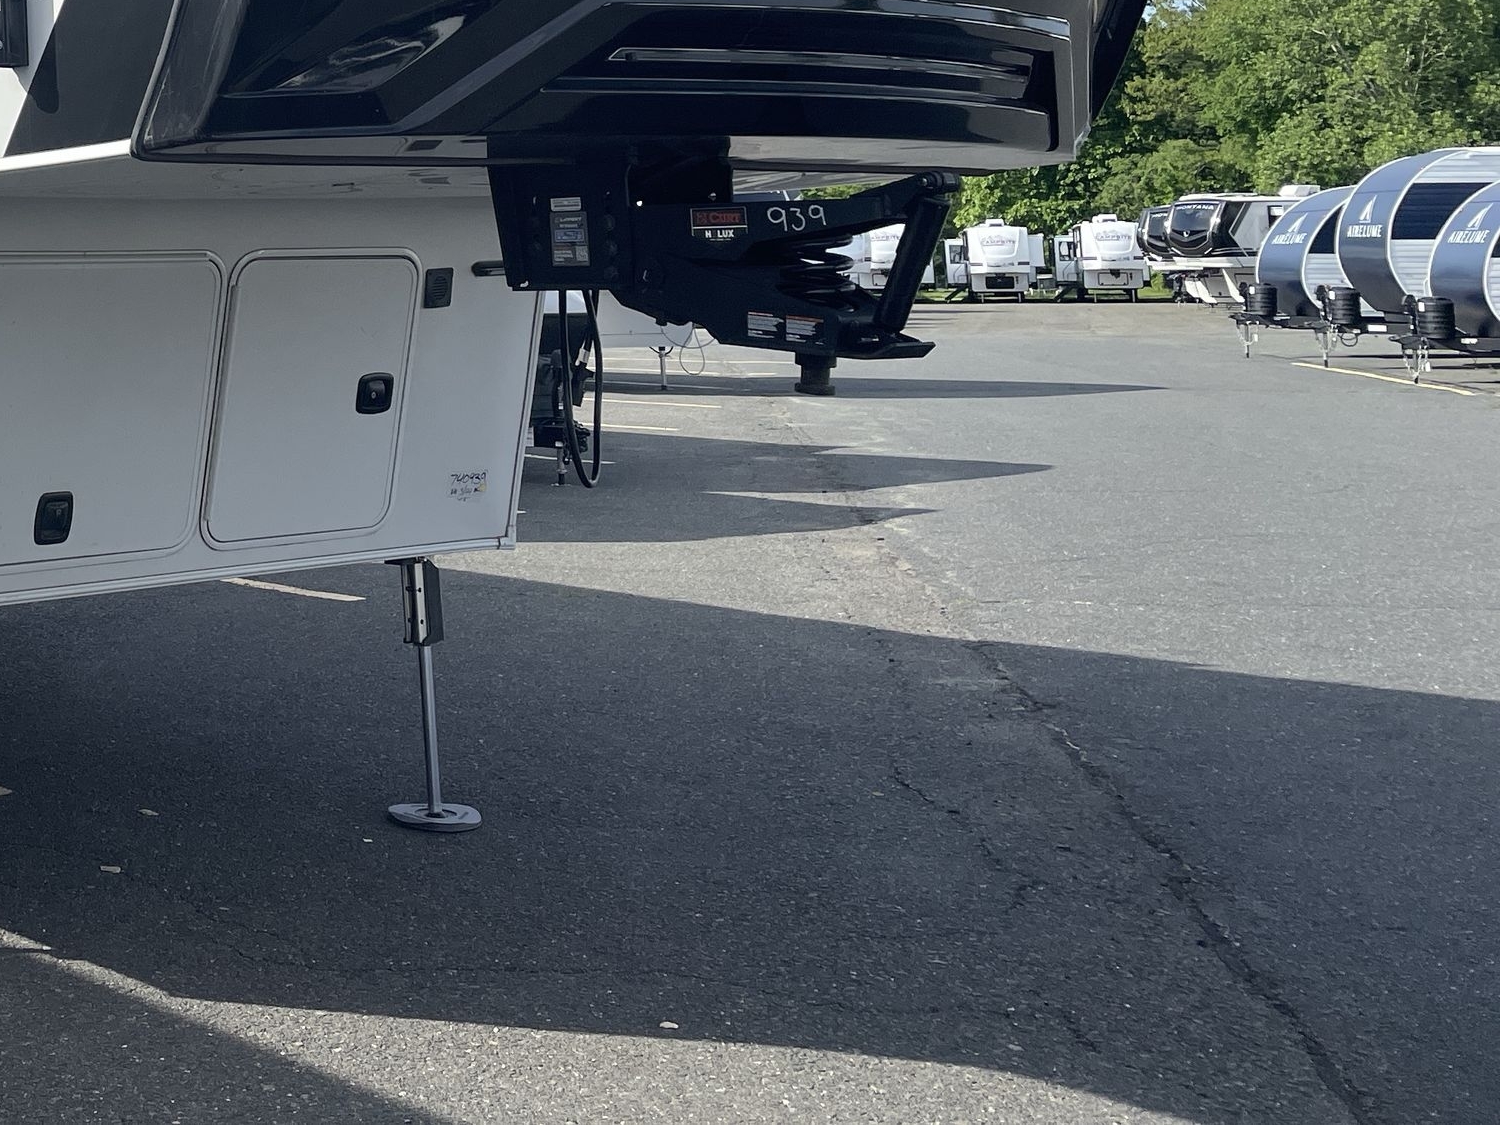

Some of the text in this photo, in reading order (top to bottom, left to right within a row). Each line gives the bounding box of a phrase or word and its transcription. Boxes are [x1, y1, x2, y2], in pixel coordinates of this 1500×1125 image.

[766, 204, 827, 232] 939
[704, 229, 735, 238] HLUX
[1347, 225, 1382, 238] AIRELUME
[1448, 229, 1490, 244] AIRELUME
[1271, 232, 1308, 245] AIRELUME
